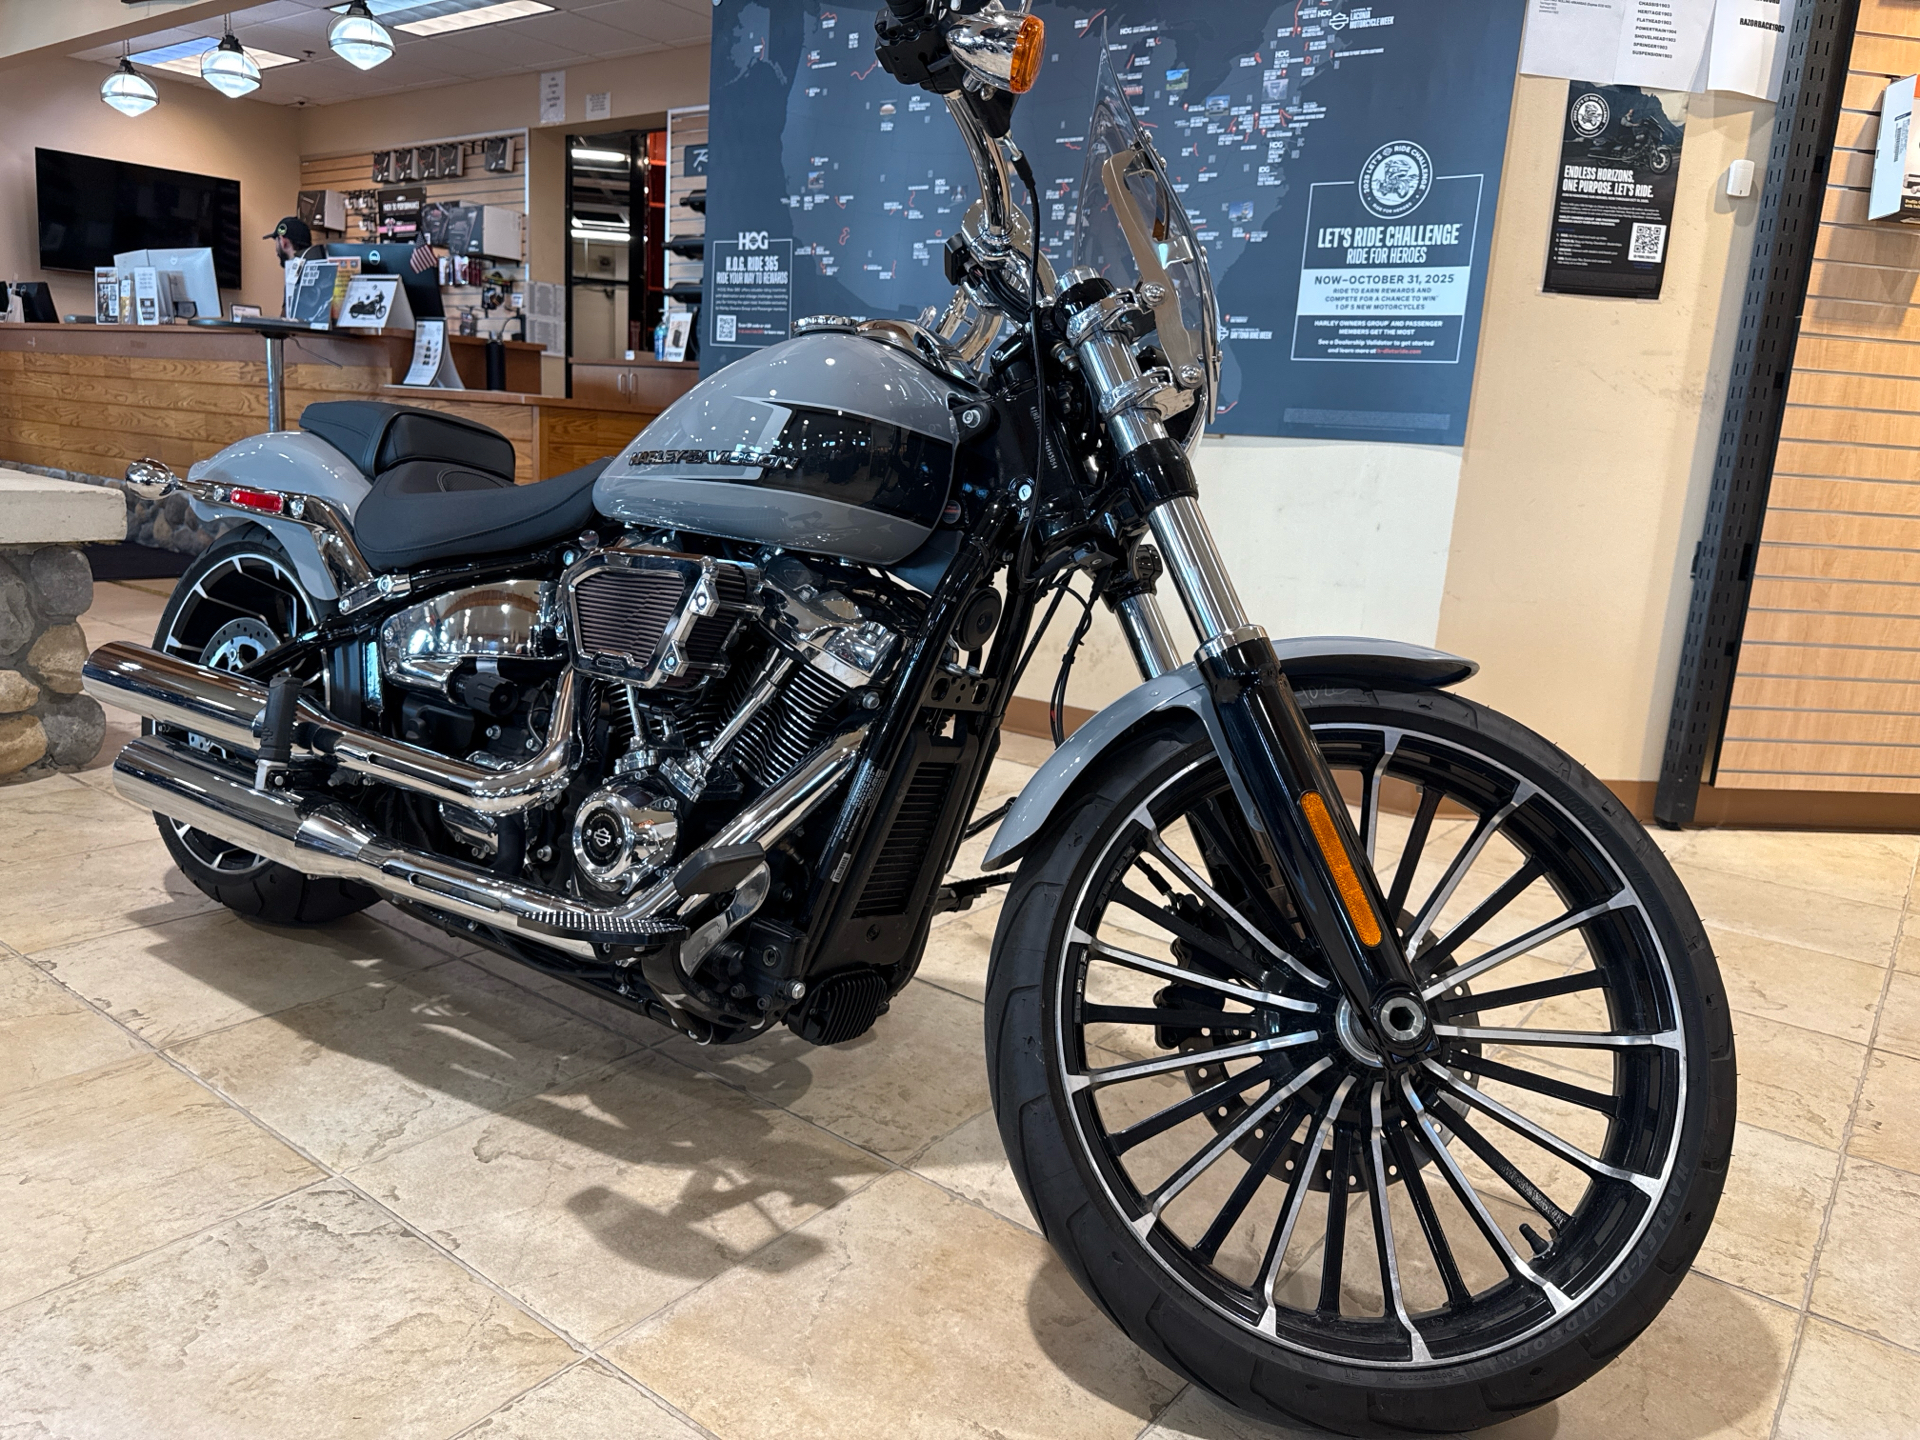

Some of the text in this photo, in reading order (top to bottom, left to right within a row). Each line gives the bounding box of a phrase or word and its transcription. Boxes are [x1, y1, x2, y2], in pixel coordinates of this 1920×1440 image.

[1349, 16, 1394, 29] MOTORCYCLE WEEK
[1350, 11, 1371, 20] LACONIA
[1739, 18, 1786, 33] RAZORBACK1903
[1275, 50, 1289, 58] HOG
[1394, 146, 1410, 154] RIDE
[1410, 148, 1429, 190] CHALLENGE
[1564, 165, 1634, 182] ENDLESS HORIZONS.
[1562, 178, 1654, 198] ONE PURPOSE. LET'S RIDE.
[738, 231, 768, 250] HOG
[1317, 224, 1461, 248] LET'S RIDE CHALLENGE
[726, 256, 746, 270] H.O.G.
[747, 256, 764, 270] RIDE
[1346, 246, 1428, 264] RIDE FOR HEROES
[716, 271, 788, 284] RIDE YOUR WAY TO REWARDS
[1407, 274, 1422, 285] 31,
[1424, 274, 1454, 284] 2025
[629, 449, 800, 470] HARLEY-DAVIDSON
[1510, 1161, 1690, 1365] HARLEY-DAVIDSON
